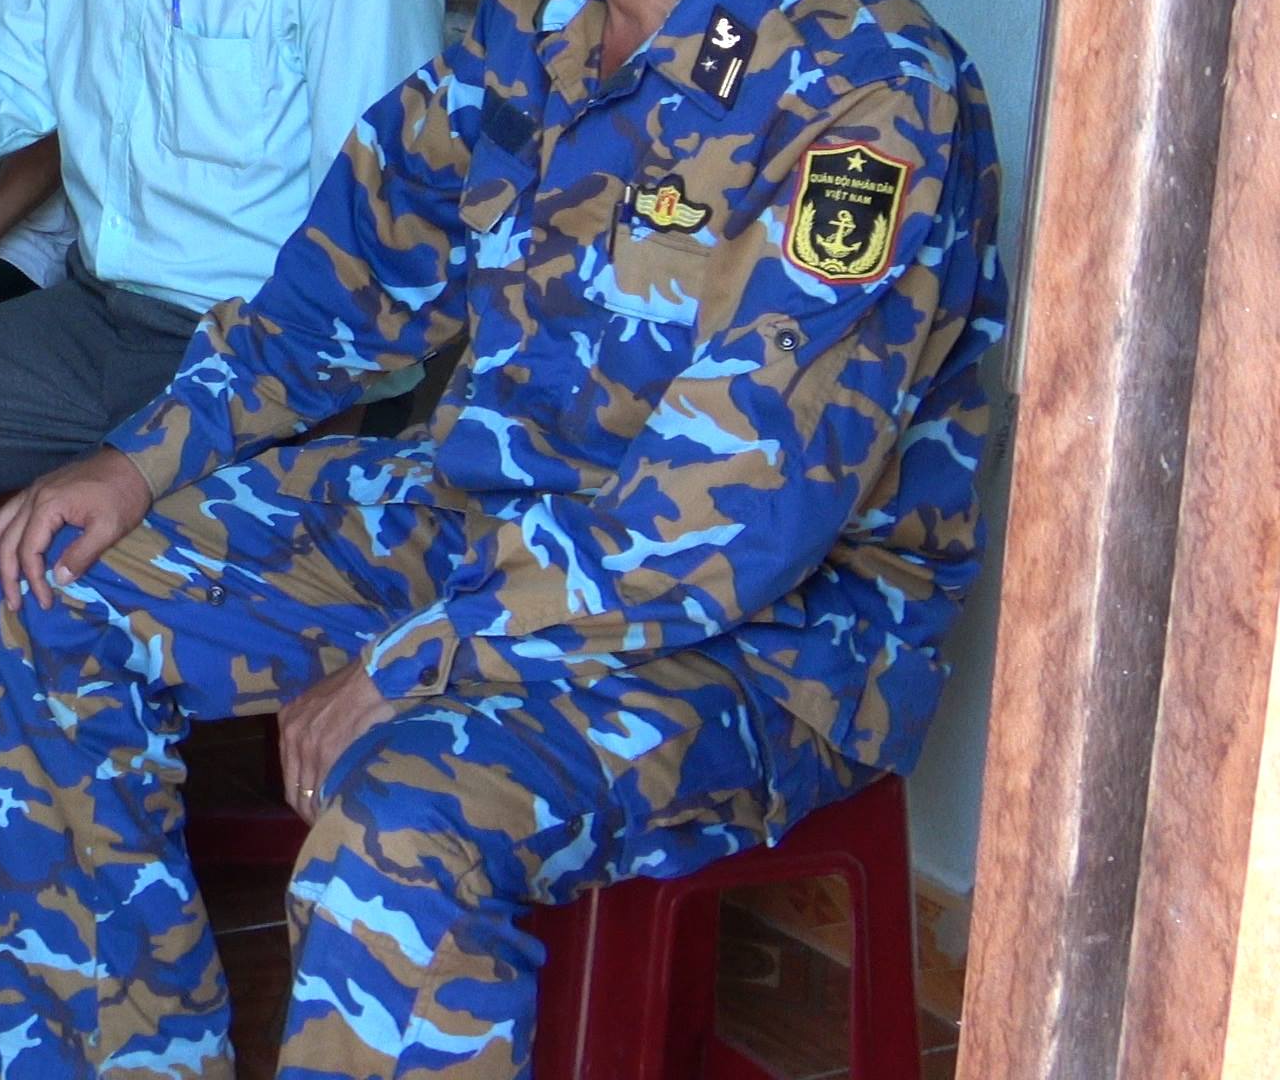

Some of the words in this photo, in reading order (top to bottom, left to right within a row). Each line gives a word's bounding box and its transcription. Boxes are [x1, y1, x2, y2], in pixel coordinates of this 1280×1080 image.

[810, 172, 835, 184] QUÂN
[835, 174, 851, 188] ĐỘI
[851, 178, 876, 191] NHÂN
[876, 182, 894, 194] DÂN
[825, 188, 848, 201] VIỆT
[849, 194, 872, 205] NAM
